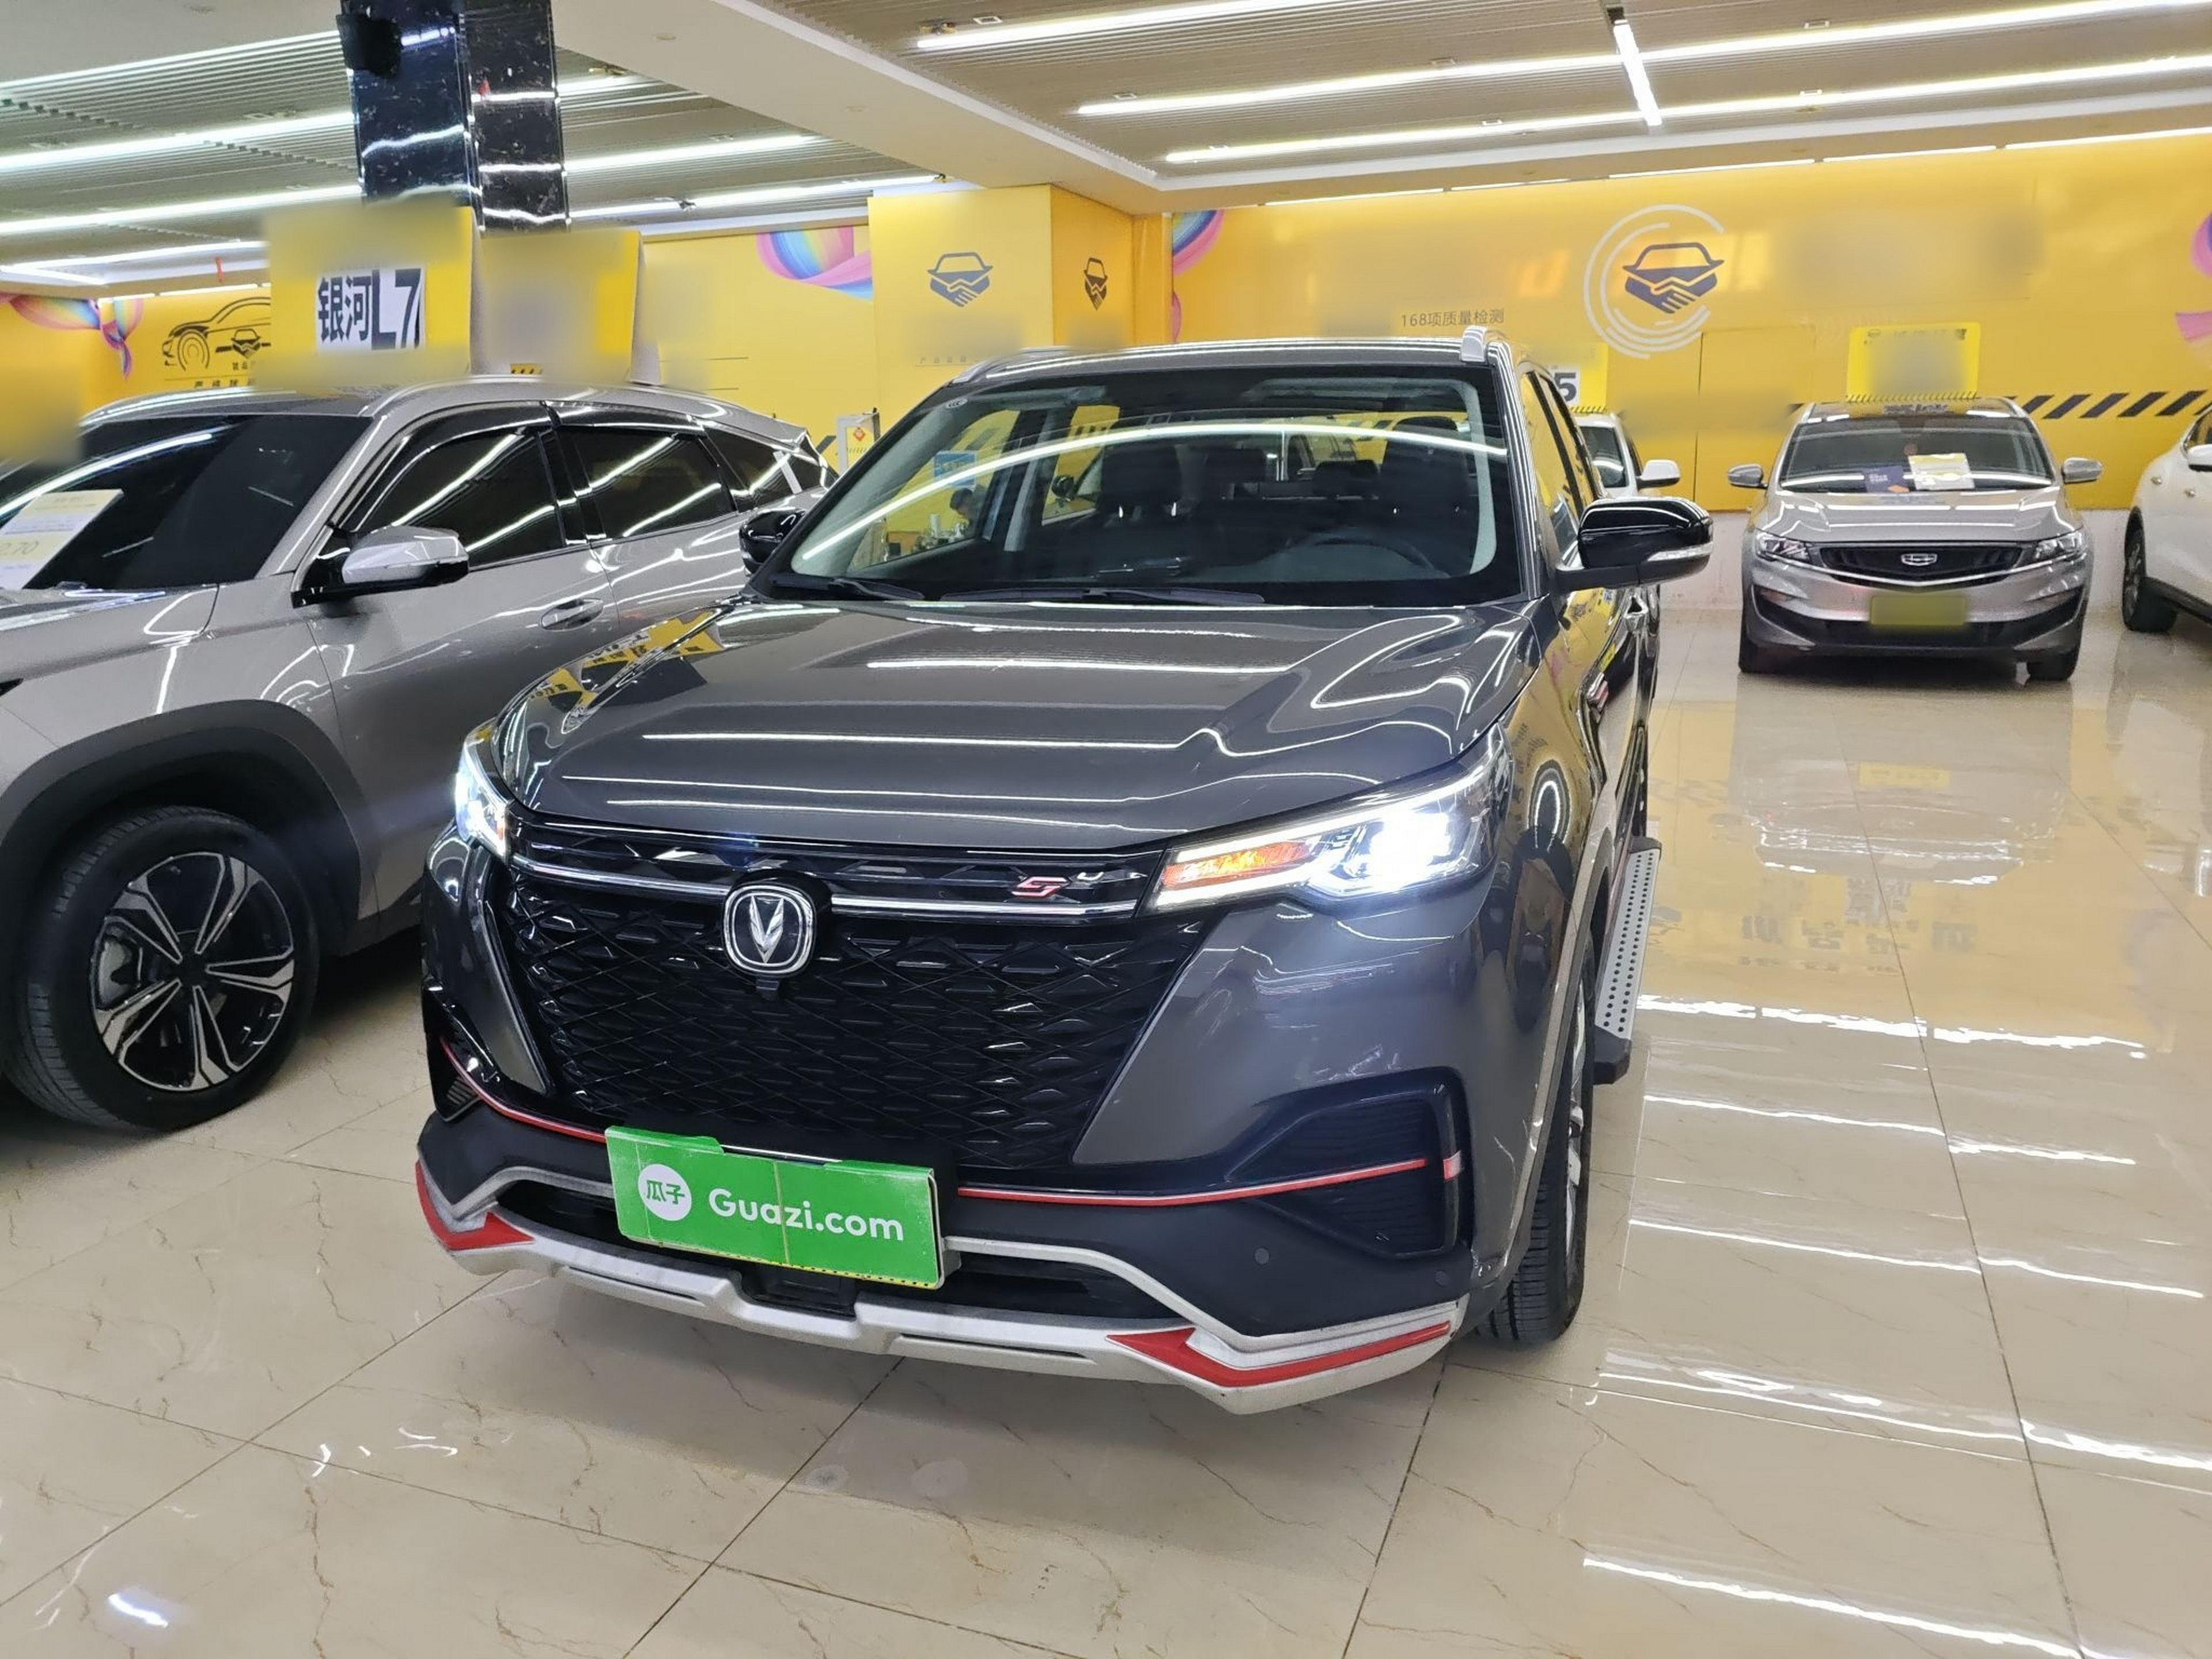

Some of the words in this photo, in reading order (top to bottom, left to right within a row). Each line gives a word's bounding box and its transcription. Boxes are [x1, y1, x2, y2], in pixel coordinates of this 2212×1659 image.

[1402, 308, 1505, 327] 168项质量检测
[647, 1179, 685, 1205] 瓜子
[709, 1188, 904, 1241] Guazi.com
